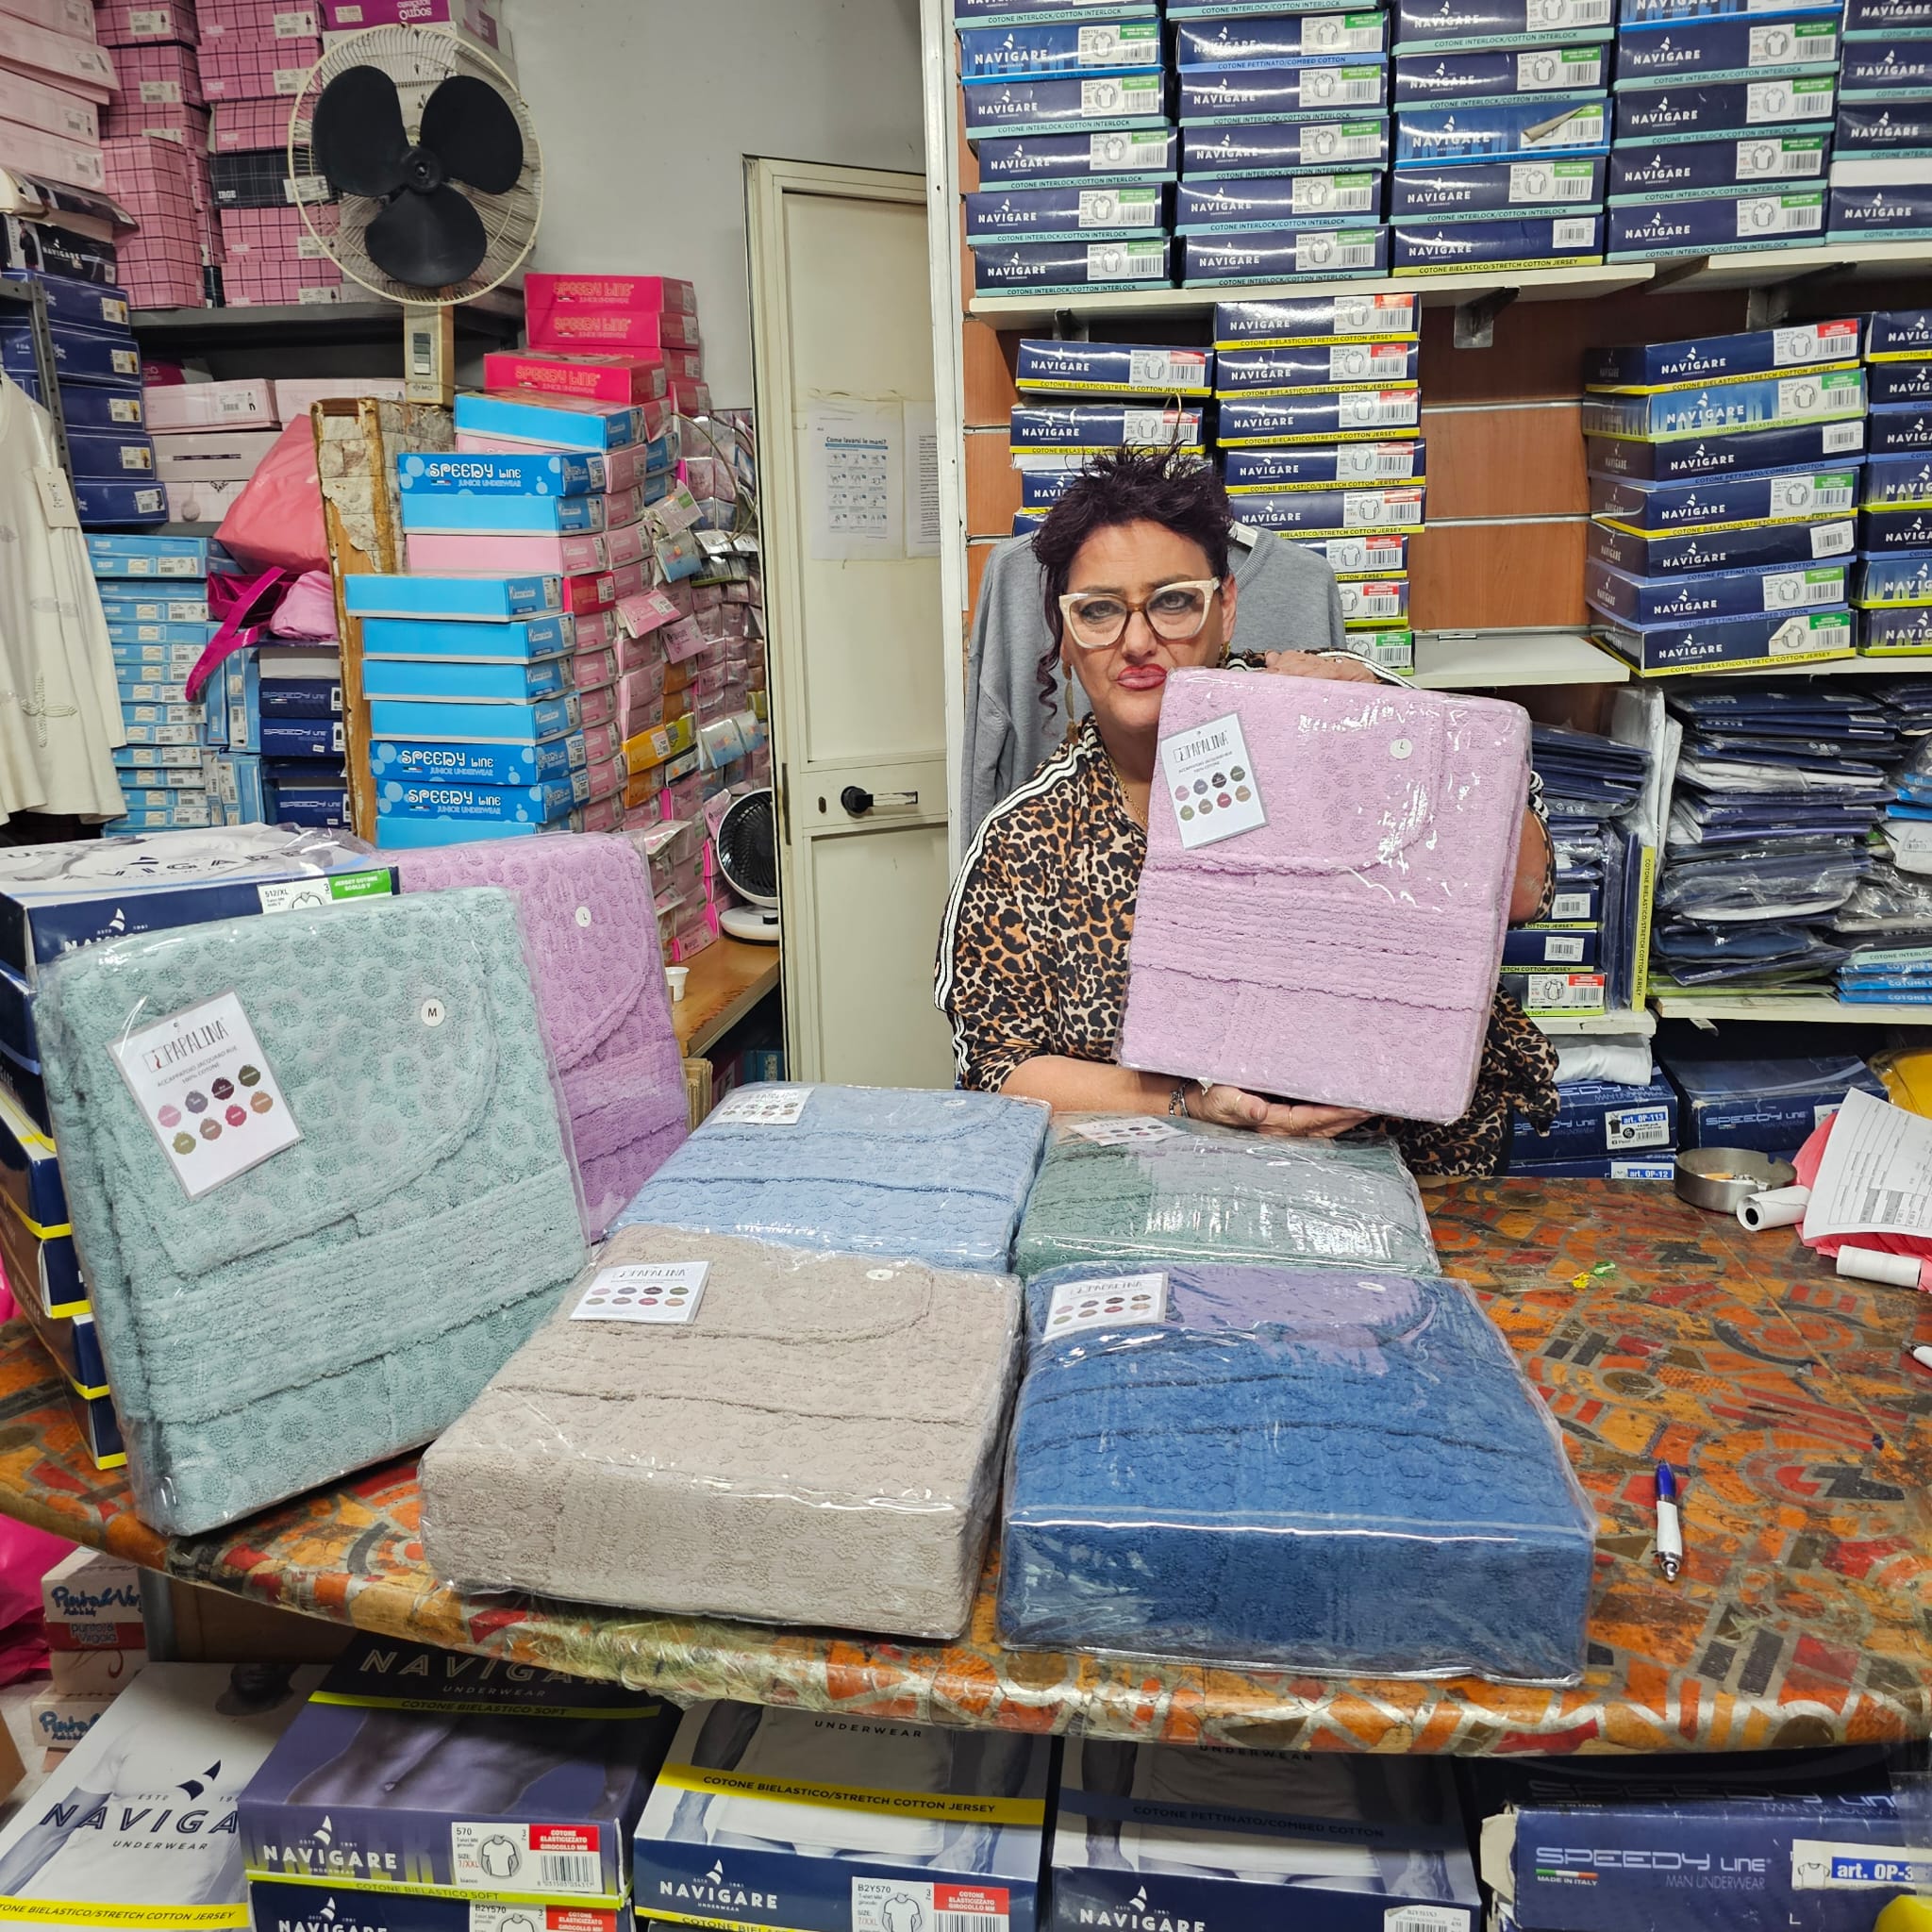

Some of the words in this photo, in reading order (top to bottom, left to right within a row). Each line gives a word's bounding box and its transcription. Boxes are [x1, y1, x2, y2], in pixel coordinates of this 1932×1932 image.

[974, 49, 1047, 64] NAVIGARE
[1633, 50, 1701, 64] NAVIGARE
[1247, 58, 1316, 68] PETTINATO/COMBED
[1857, 64, 1925, 76] NAVIGARE
[1194, 94, 1256, 105] NAVIGARE
[1412, 136, 1490, 148] NAVIGARE
[991, 159, 1050, 170] NAVIGARE
[1039, 178, 1101, 187] INTERLOCK/COTTON
[1407, 191, 1471, 203] NAVIGARE
[978, 212, 1037, 223] NAVIGARE
[1845, 208, 1911, 218] NAVIGARE
[1625, 225, 1690, 239] NAVIGARE
[1409, 245, 1472, 257] NAVIGARE
[1676, 245, 1747, 256] INTERLOCK/COTTON
[1200, 256, 1260, 267] NAVIGARE
[1449, 262, 1522, 272] BIELASTICO/STRETCH
[988, 265, 1046, 276] NAVIGARE
[1031, 360, 1090, 371] NAVIGARE
[1661, 358, 1726, 375] NAVIGARE
[1667, 406, 1744, 424] NAVIGARE
[1234, 417, 1293, 428] NAVIGARE
[1746, 421, 1781, 430] BIELASTICO
[1273, 434, 1342, 443] BIELASTICO/STRETCH
[1671, 455, 1735, 471] NAVIGARE
[429, 462, 493, 478] SPEEDY
[499, 468, 522, 478] LINE
[1240, 465, 1298, 475] NAVIGARE
[1687, 572, 1716, 580] COTONE
[1717, 564, 1785, 577] PETTINATO/COMBED
[1786, 560, 1817, 570] COTTON
[1654, 600, 1717, 615] NAVIGARE
[1659, 644, 1723, 658] NAVIGARE
[402, 750, 466, 766] SPEEDY
[472, 757, 493, 768] LINE
[454, 768, 493, 776] UNDERWEAR
[408, 790, 473, 805] SPEEDY
[478, 795, 501, 806] LINE
[437, 806, 459, 814] JUNIOR
[461, 807, 501, 815] UNDERWEAR
[265, 889, 289, 897] 512/XL
[428, 1008, 437, 1017] M
[1623, 1116, 1637, 1124] art.
[1638, 1113, 1664, 1123] OP-113
[1706, 1112, 1784, 1125] SPEEDY
[1786, 1111, 1807, 1120] LINE
[1645, 1170, 1669, 1178] OP-12
[442, 1685, 545, 1697] UNDERWEAR
[402, 1700, 454, 1709] COTONE
[457, 1702, 531, 1714] BIELASTICO
[534, 1707, 566, 1717] SOFT
[814, 1721, 923, 1738] UNDERWEAR
[1199, 1745, 1313, 1762] UNDERWEAR
[703, 1775, 755, 1789] COTONE
[758, 1782, 890, 1806] BIELASTICO/STRETCH
[893, 1797, 945, 1809] COTTON
[948, 1801, 995, 1813] JERSEY
[1133, 1807, 1188, 1820] COTONE
[1191, 1811, 1325, 1833] PETTINATO/COMBED
[1329, 1825, 1386, 1838] COTTON
[113, 1840, 208, 1850] UNDERWEAR
[263, 1845, 397, 1869] NAVIGARE
[1536, 1847, 1710, 1871] SPEEDY
[1721, 1857, 1767, 1872] LINE
[1837, 1862, 1868, 1880] art.
[1537, 1875, 1561, 1884] MADE
[1574, 1877, 1598, 1886] ITALY
[1666, 1874, 1694, 1887] MAN
[1697, 1875, 1766, 1890] UNDERWEAR
[356, 1883, 402, 1894] COTONE
[404, 1886, 469, 1899] BIELASTICO
[471, 1891, 499, 1901] SOFT
[858, 1884, 891, 1893] B2Y570
[660, 1881, 777, 1909] NAVIGARE
[28, 1906, 143, 1919] BIELASTICO/STRETCH
[475, 1905, 506, 1913] B2Y570
[698, 1903, 739, 1911] UNDERWEAR
[278, 1920, 388, 1932] NAVIGA
[682, 1917, 733, 1932] COTONE
[1080, 1909, 1206, 1932] NAVIGARE
